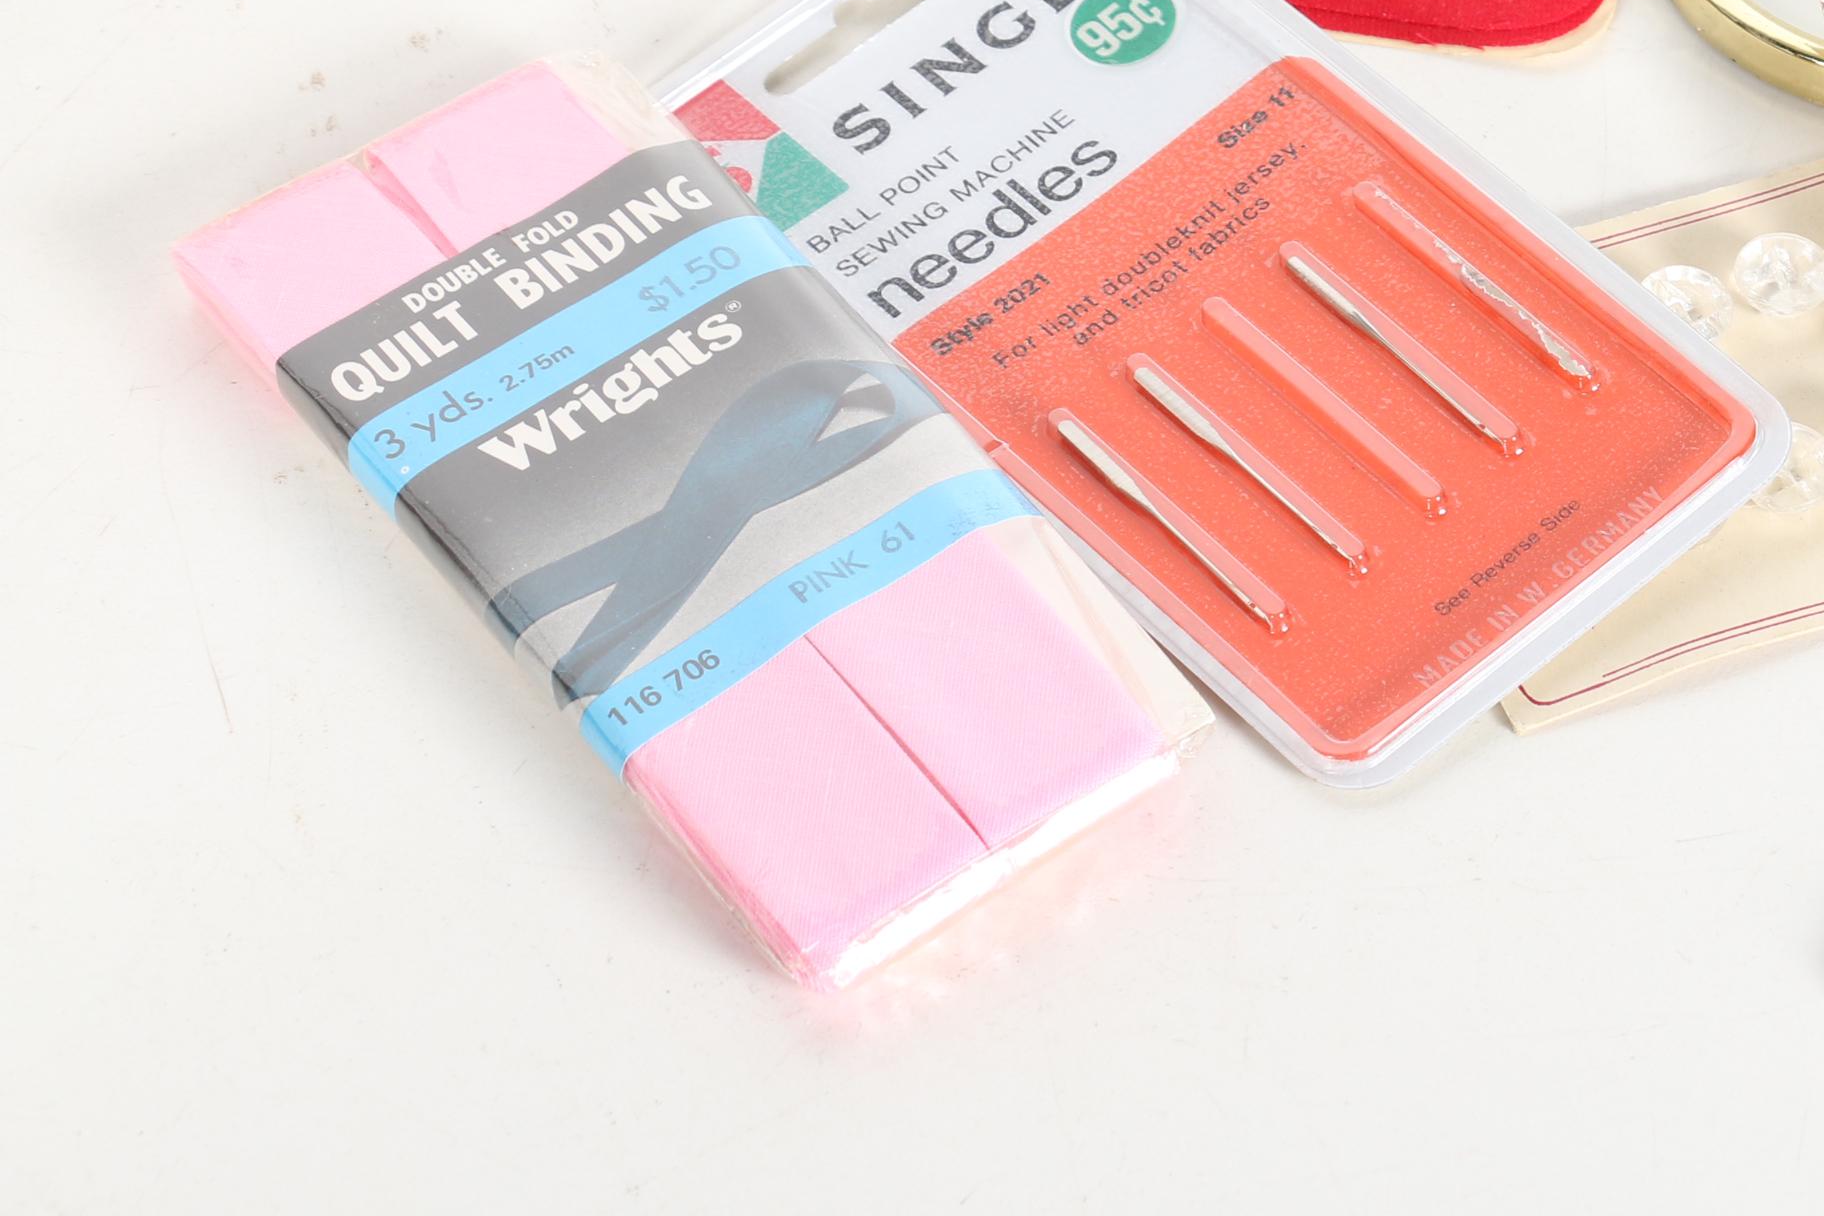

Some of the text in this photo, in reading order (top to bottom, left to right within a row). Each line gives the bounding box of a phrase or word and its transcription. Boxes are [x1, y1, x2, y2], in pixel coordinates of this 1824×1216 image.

[1217, 85, 1296, 150] Size 11
[806, 144, 962, 255] BALL POINT
[836, 108, 1076, 278] SEWING MACHINE
[867, 138, 1118, 320] needles
[330, 174, 712, 403] QUILT BINDING
[402, 209, 580, 312] DOUBLE FOLD
[636, 245, 742, 314] $1.50
[930, 272, 1051, 356] Style 2021
[992, 336, 1037, 369] For
[1040, 294, 1099, 337] light
[1103, 200, 1226, 296] doubleknit
[1073, 197, 1270, 346] and tricot fabrics
[373, 345, 576, 461] 3 yds. 2.75m
[787, 519, 918, 604] PINK 61
[1413, 627, 1483, 688] MADE
[1487, 603, 1519, 633] IN
[1551, 485, 1665, 581] GERMANY
[1434, 499, 1580, 616] See Reverse Side
[608, 647, 722, 729] 116 706
